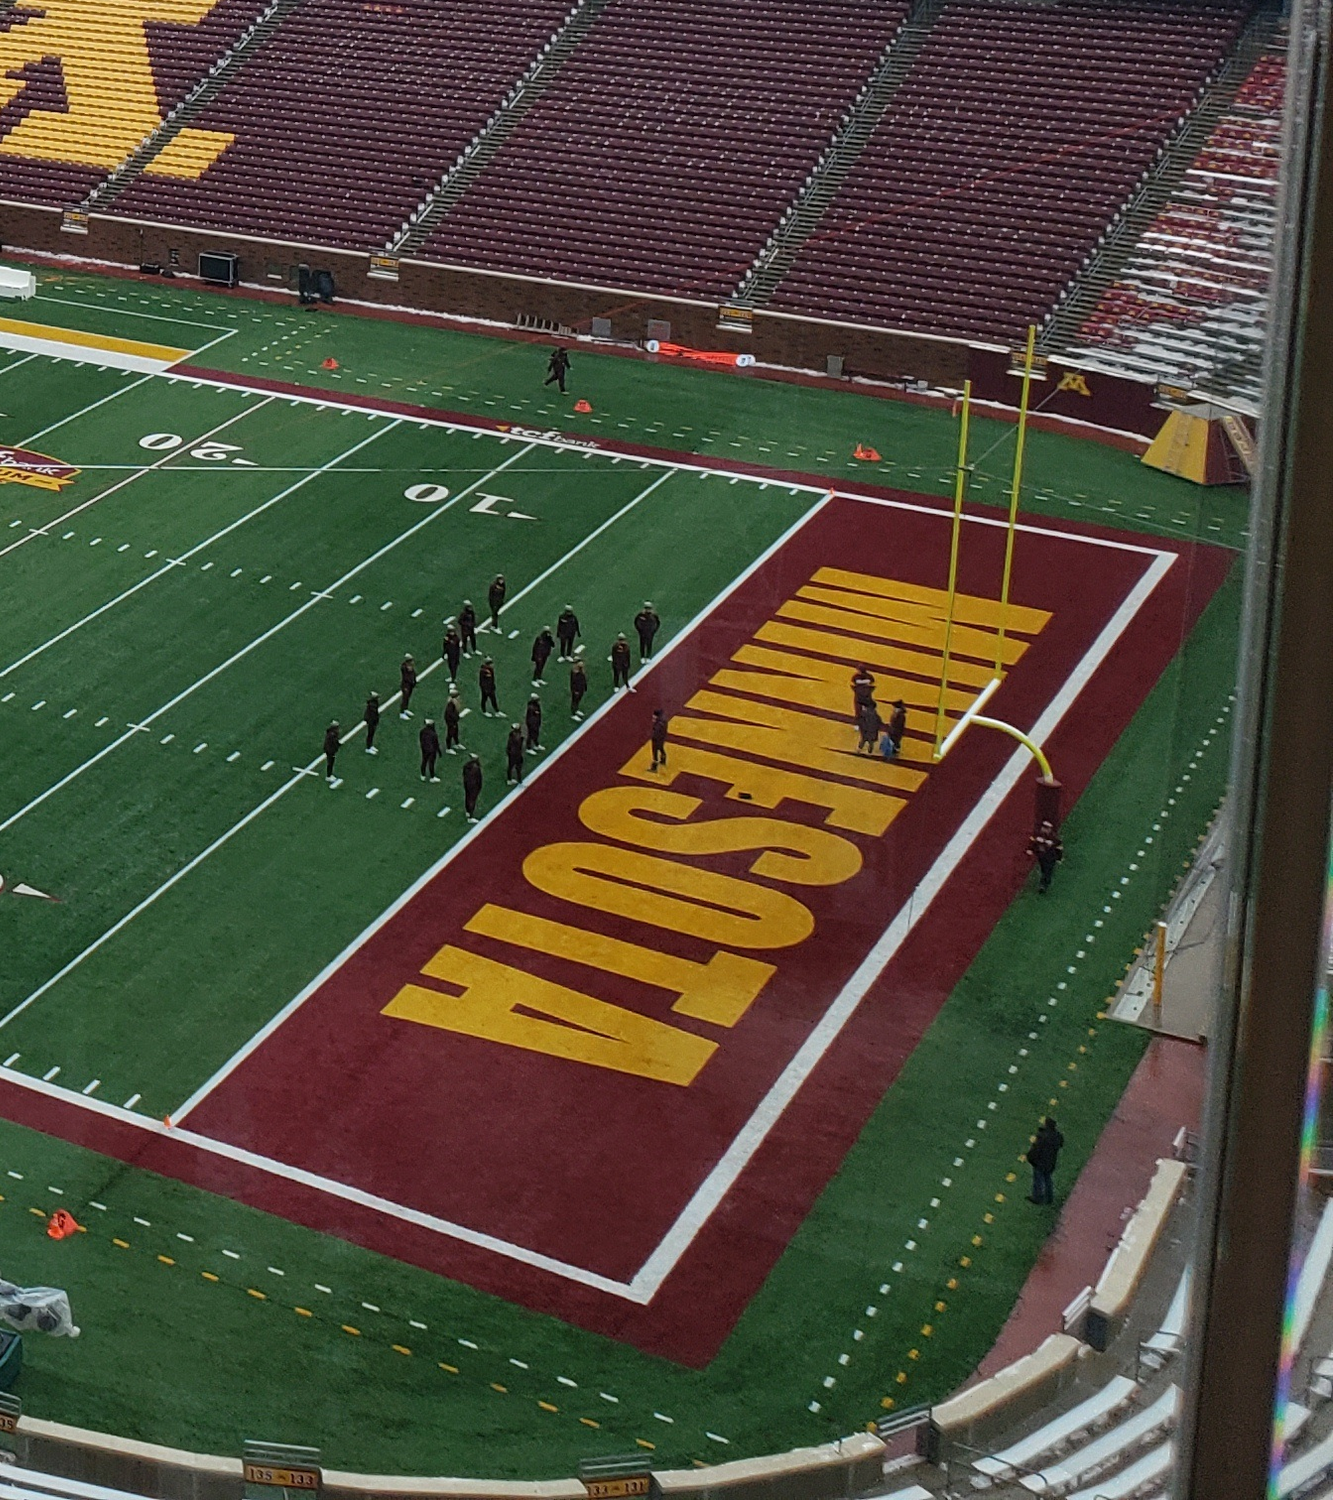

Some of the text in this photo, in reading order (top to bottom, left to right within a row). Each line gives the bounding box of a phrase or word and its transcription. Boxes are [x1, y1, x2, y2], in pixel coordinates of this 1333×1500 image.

[138, 432, 244, 462] 20
[403, 482, 517, 516] 10
[380, 565, 1054, 1088] MINNESOTA
[250, 1468, 314, 1485] 135 133
[624, 1481, 644, 1493] 131
